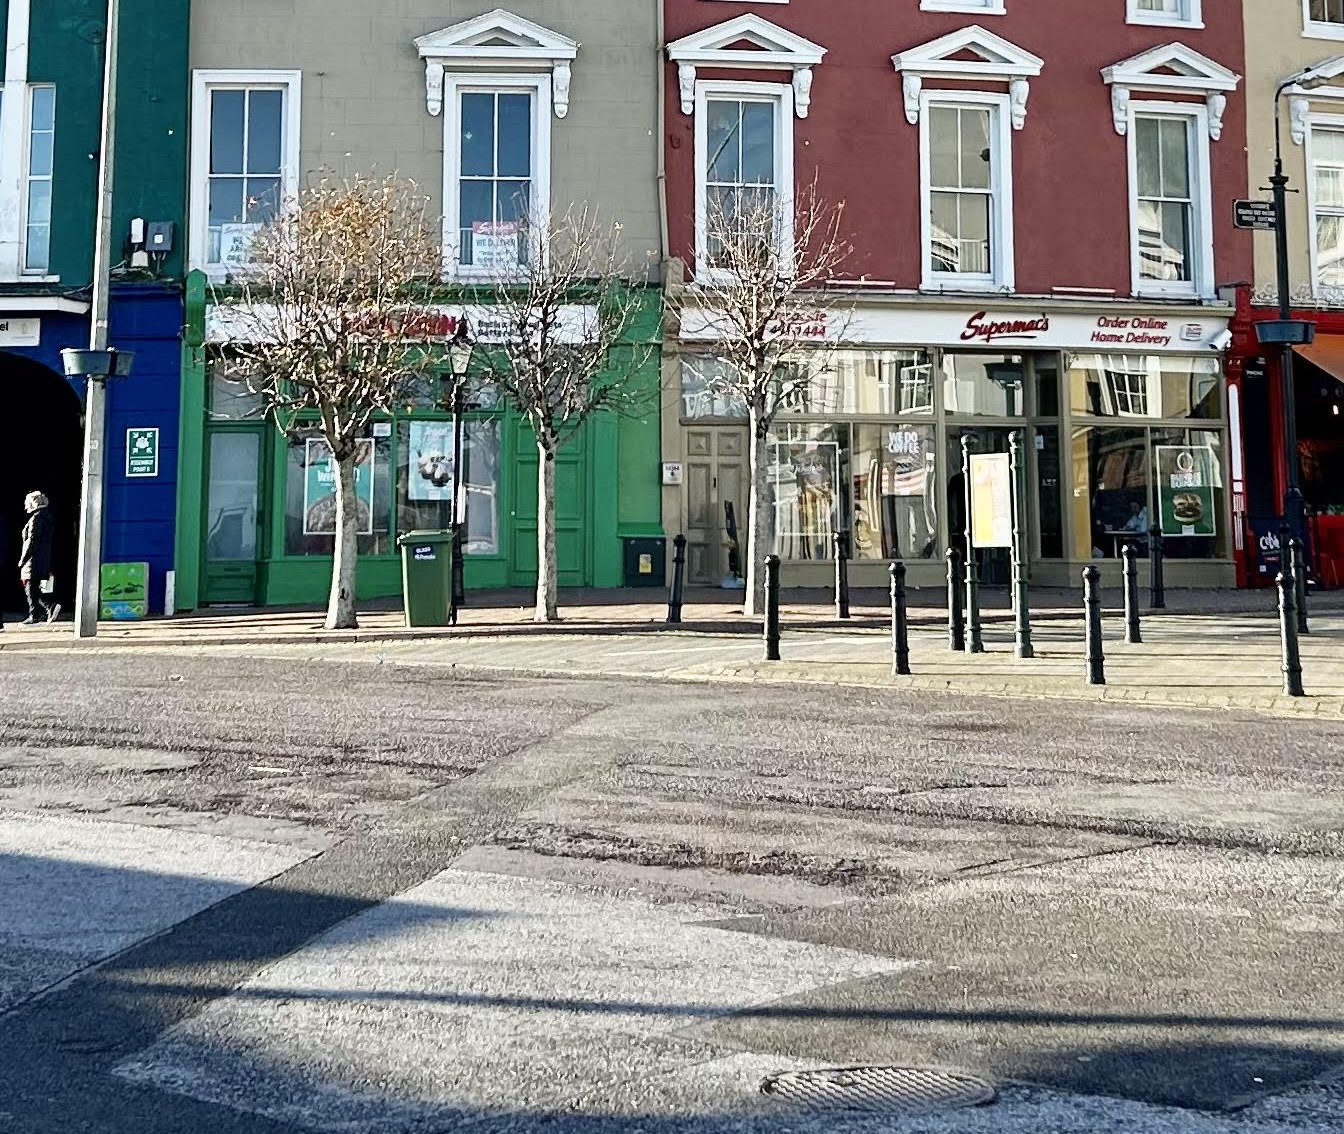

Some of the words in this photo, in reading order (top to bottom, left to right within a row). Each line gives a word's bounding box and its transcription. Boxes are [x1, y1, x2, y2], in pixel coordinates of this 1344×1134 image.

[960, 311, 1049, 342] Supermac's
[1097, 316, 1129, 329] Order
[1134, 317, 1168, 330] Online
[1090, 332, 1122, 344] Home
[1126, 332, 1171, 346] Delivery
